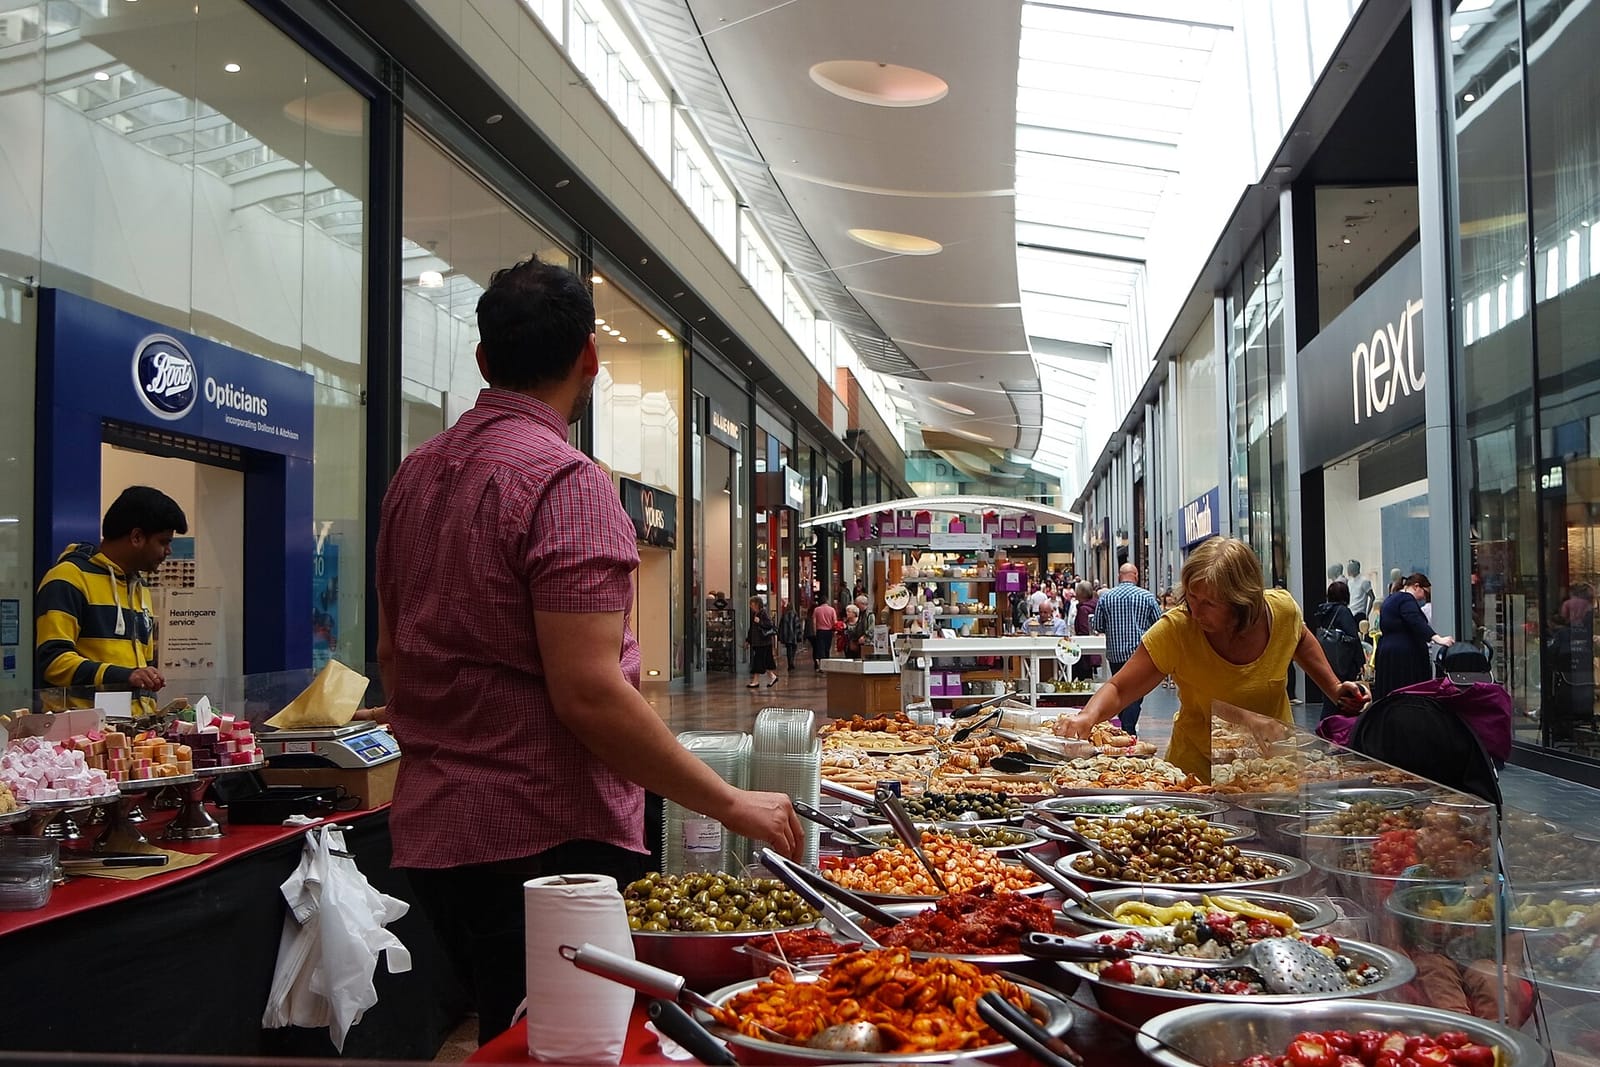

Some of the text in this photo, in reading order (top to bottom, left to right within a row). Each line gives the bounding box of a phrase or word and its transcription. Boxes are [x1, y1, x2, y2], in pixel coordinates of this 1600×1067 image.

[146, 352, 193, 397] Boots
[1352, 299, 1426, 424] next
[205, 376, 268, 417] Opticians
[225, 413, 257, 432] incorporating
[645, 506, 665, 529] YOURS
[1184, 494, 1212, 545] WHSmith
[169, 609, 217, 618] Hearingcare
